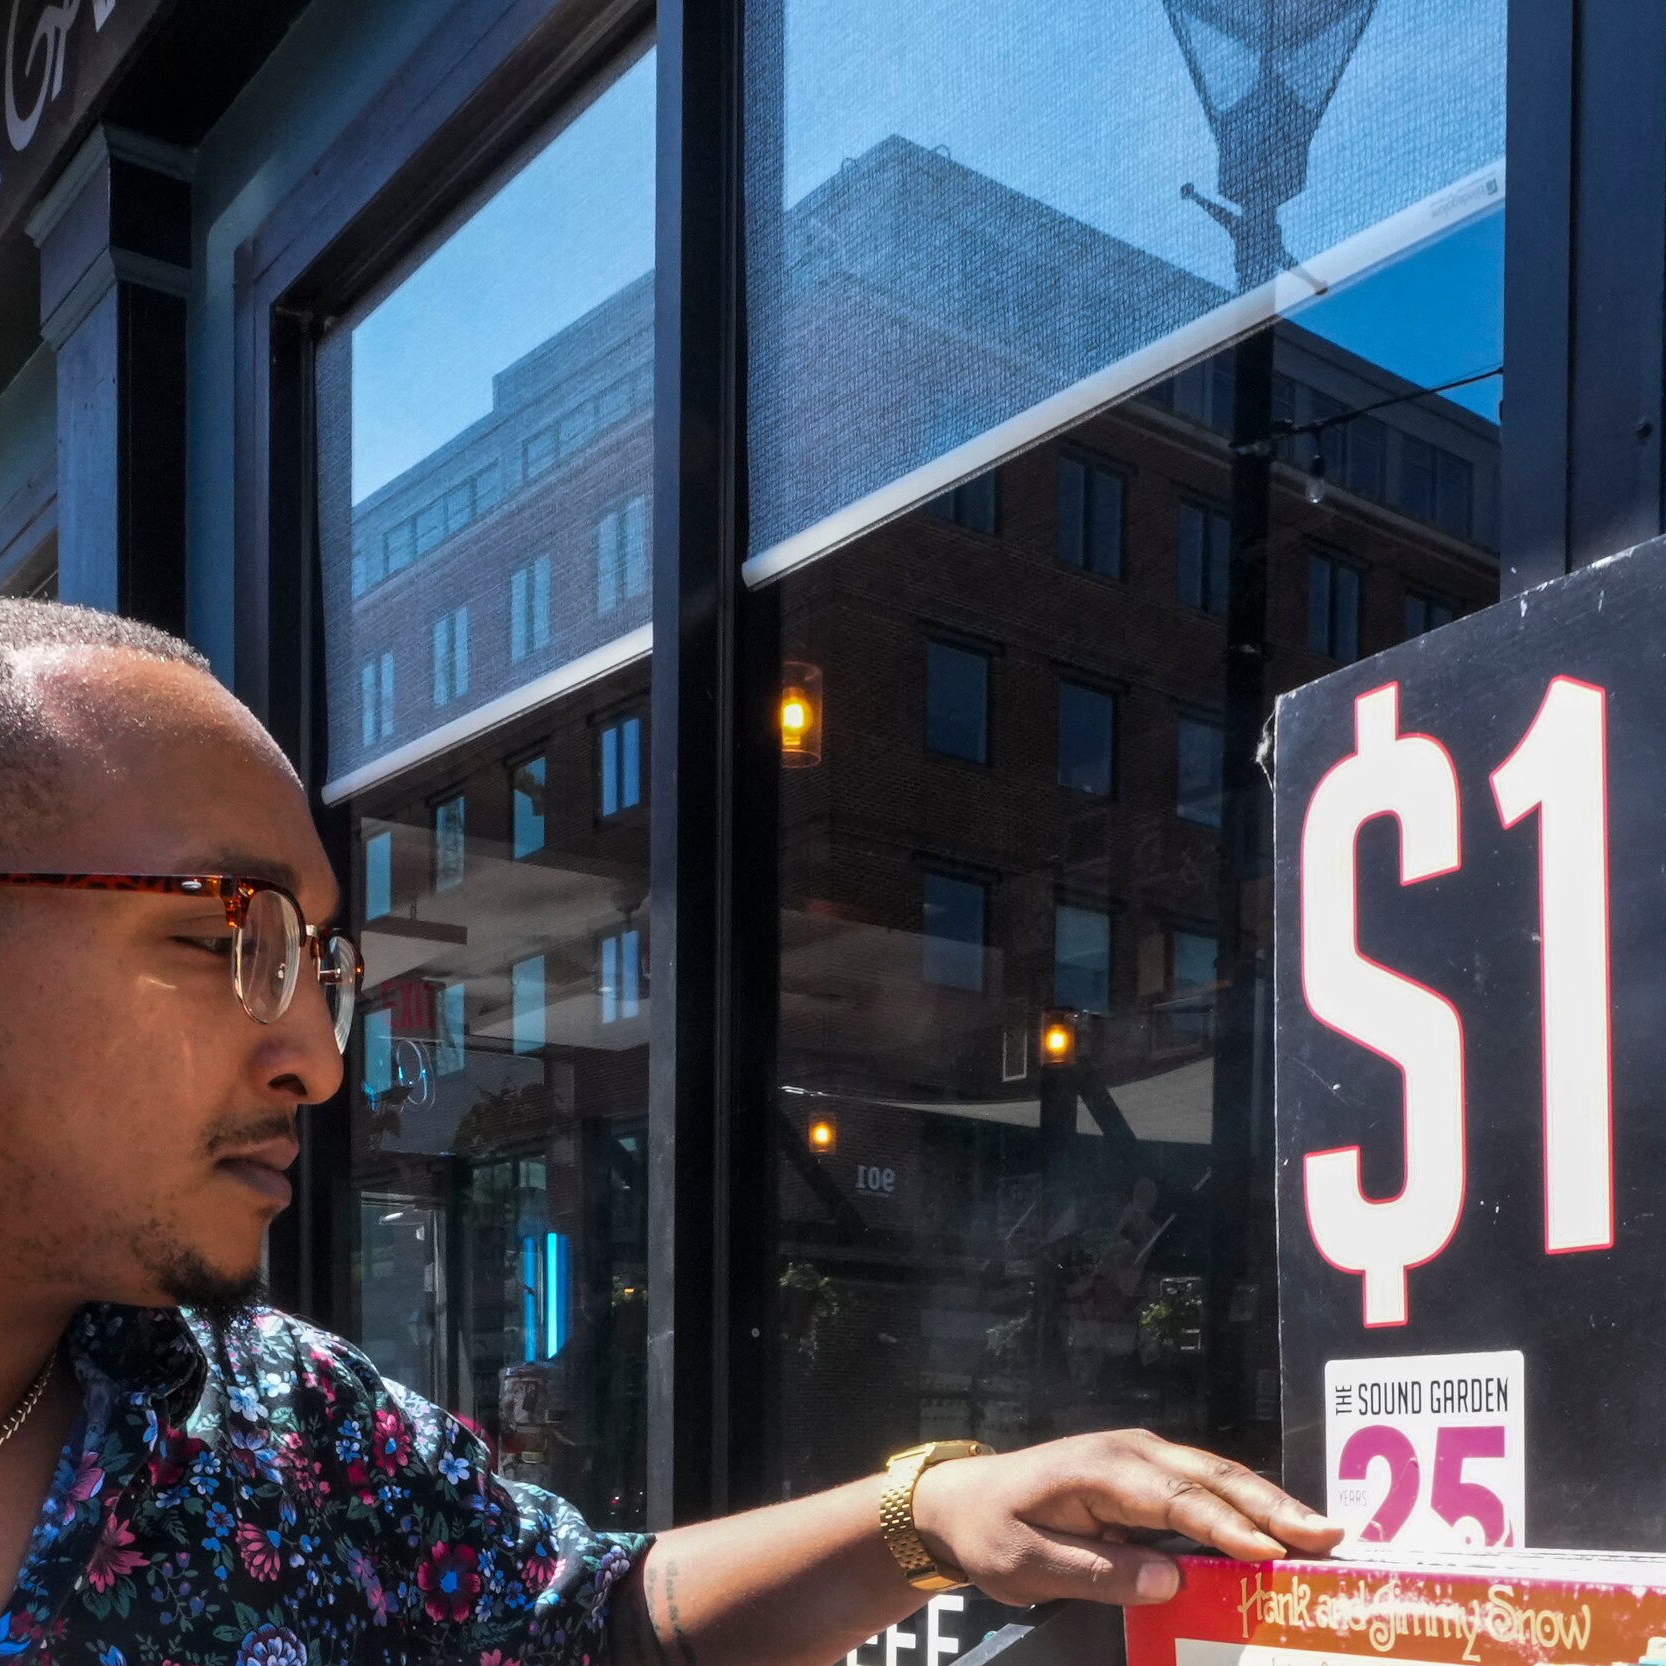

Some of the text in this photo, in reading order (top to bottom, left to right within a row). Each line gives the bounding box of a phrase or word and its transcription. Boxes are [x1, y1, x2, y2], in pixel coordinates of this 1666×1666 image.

[1301, 674, 1614, 1327] $1
[1336, 1377, 1509, 1416] THE SOUND GARDEN
[1338, 1424, 1514, 1548] 25
[1339, 1489, 1368, 1507] YEARS
[1237, 1571, 1591, 1663] Hank and Jimmy Snow
